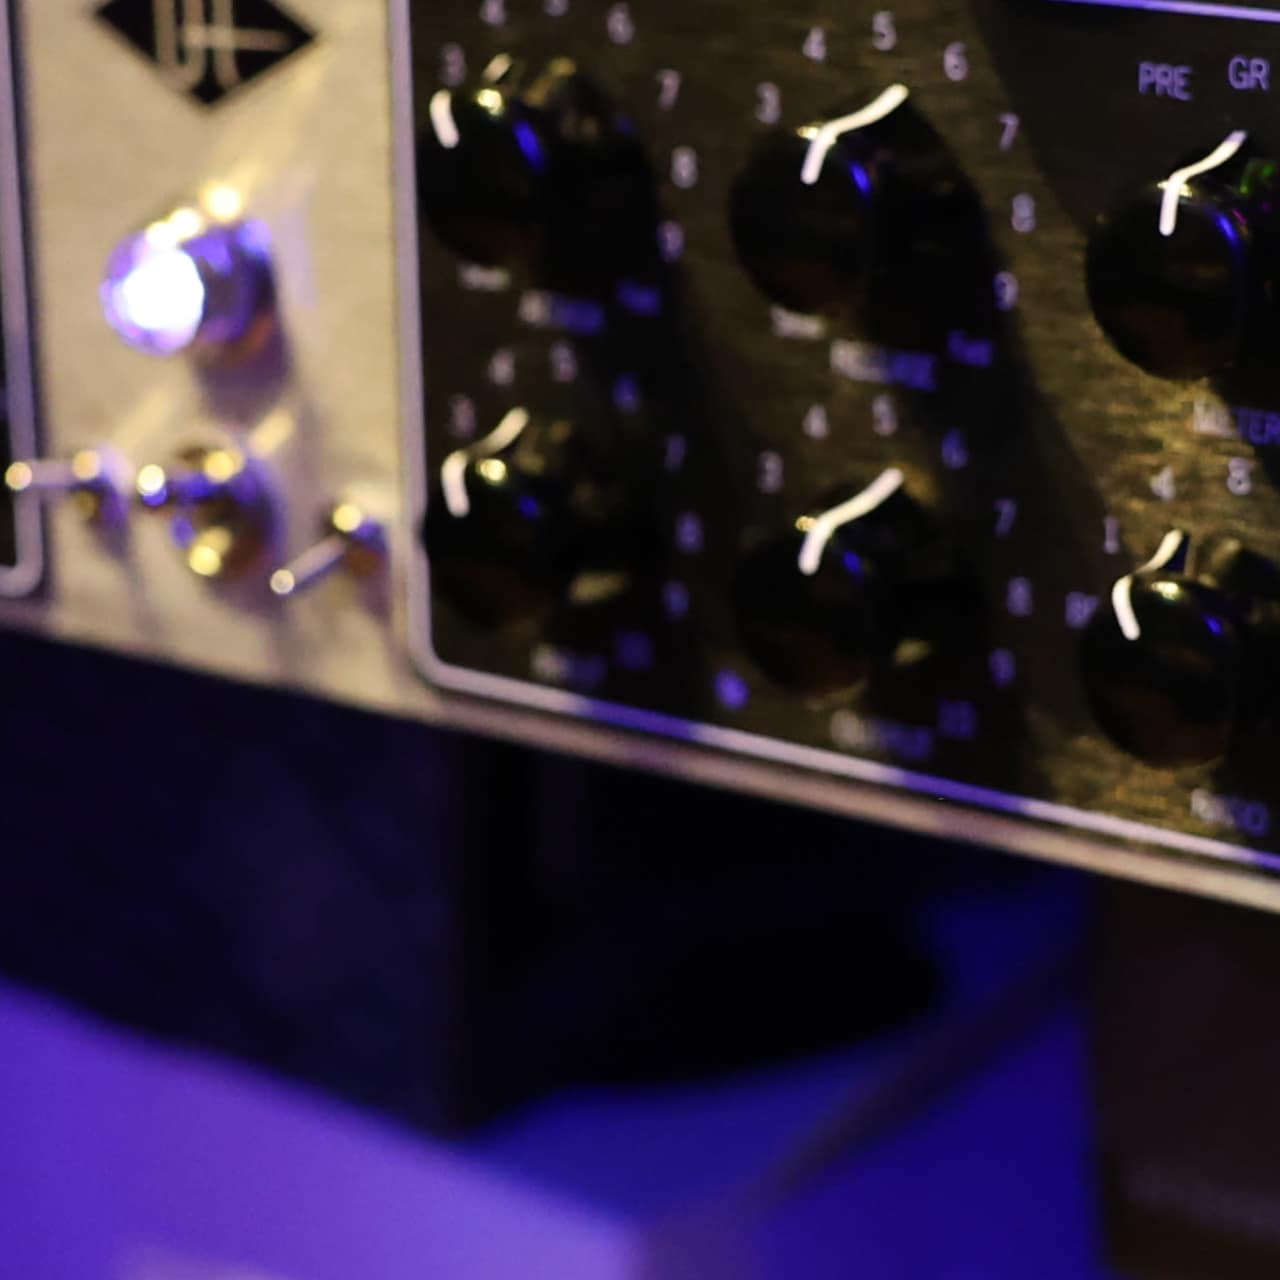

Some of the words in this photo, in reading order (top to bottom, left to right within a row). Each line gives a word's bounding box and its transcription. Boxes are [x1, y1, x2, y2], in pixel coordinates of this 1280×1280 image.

[1138, 61, 1193, 101] PRE
[1228, 56, 1270, 91] GR
[998, 112, 1019, 150] 7
[1226, 457, 1251, 496] 8
